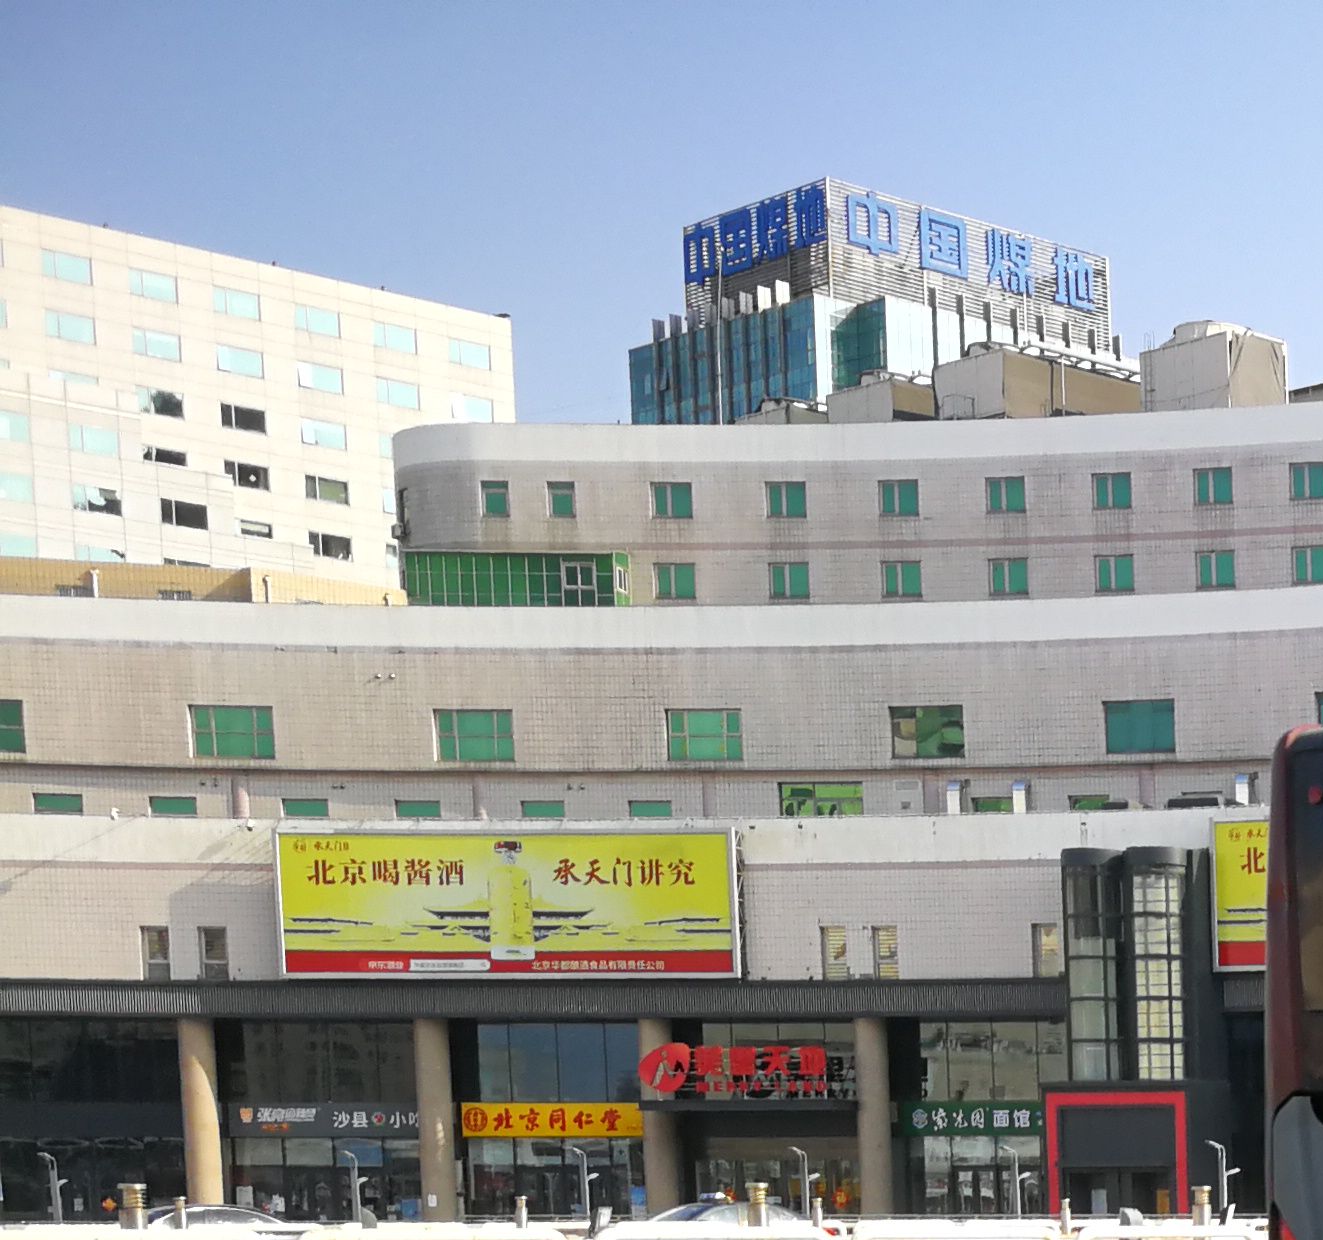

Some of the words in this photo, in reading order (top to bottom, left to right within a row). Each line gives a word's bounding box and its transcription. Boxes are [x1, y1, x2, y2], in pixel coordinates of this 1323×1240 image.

[683, 182, 828, 286] 中国煤地
[846, 192, 1096, 312] 中国煤地
[306, 858, 465, 886] 北京喝酱酒
[552, 857, 696, 886] 承天门讲究
[333, 1111, 369, 1128] 沙县
[493, 1108, 621, 1132] 北京同仁堂
[992, 1109, 1031, 1128] 面馆
